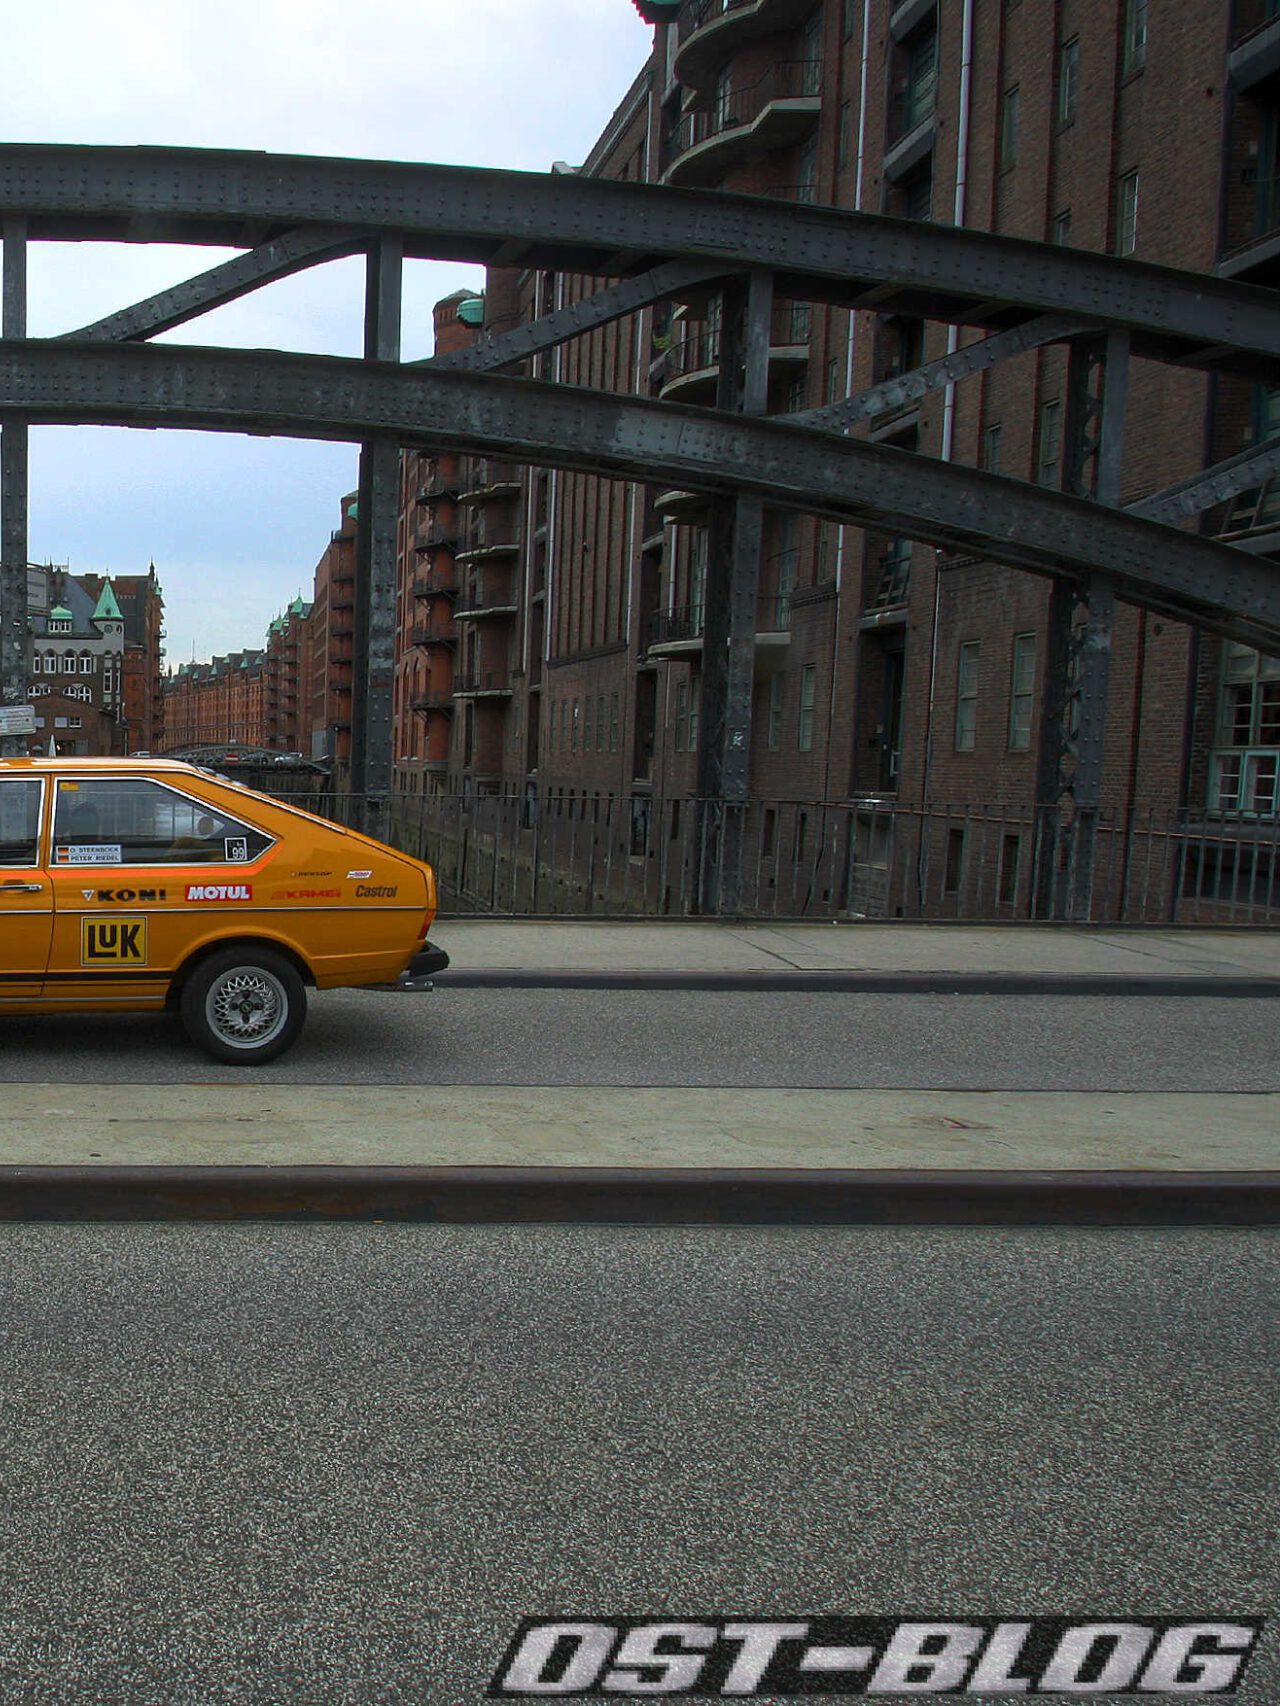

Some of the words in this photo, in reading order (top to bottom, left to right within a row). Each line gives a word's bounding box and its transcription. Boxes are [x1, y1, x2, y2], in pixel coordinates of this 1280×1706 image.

[232, 846, 245, 859] 99
[97, 889, 166, 901] KONI
[187, 886, 250, 900] MOTUL
[355, 885, 398, 898] Castrol
